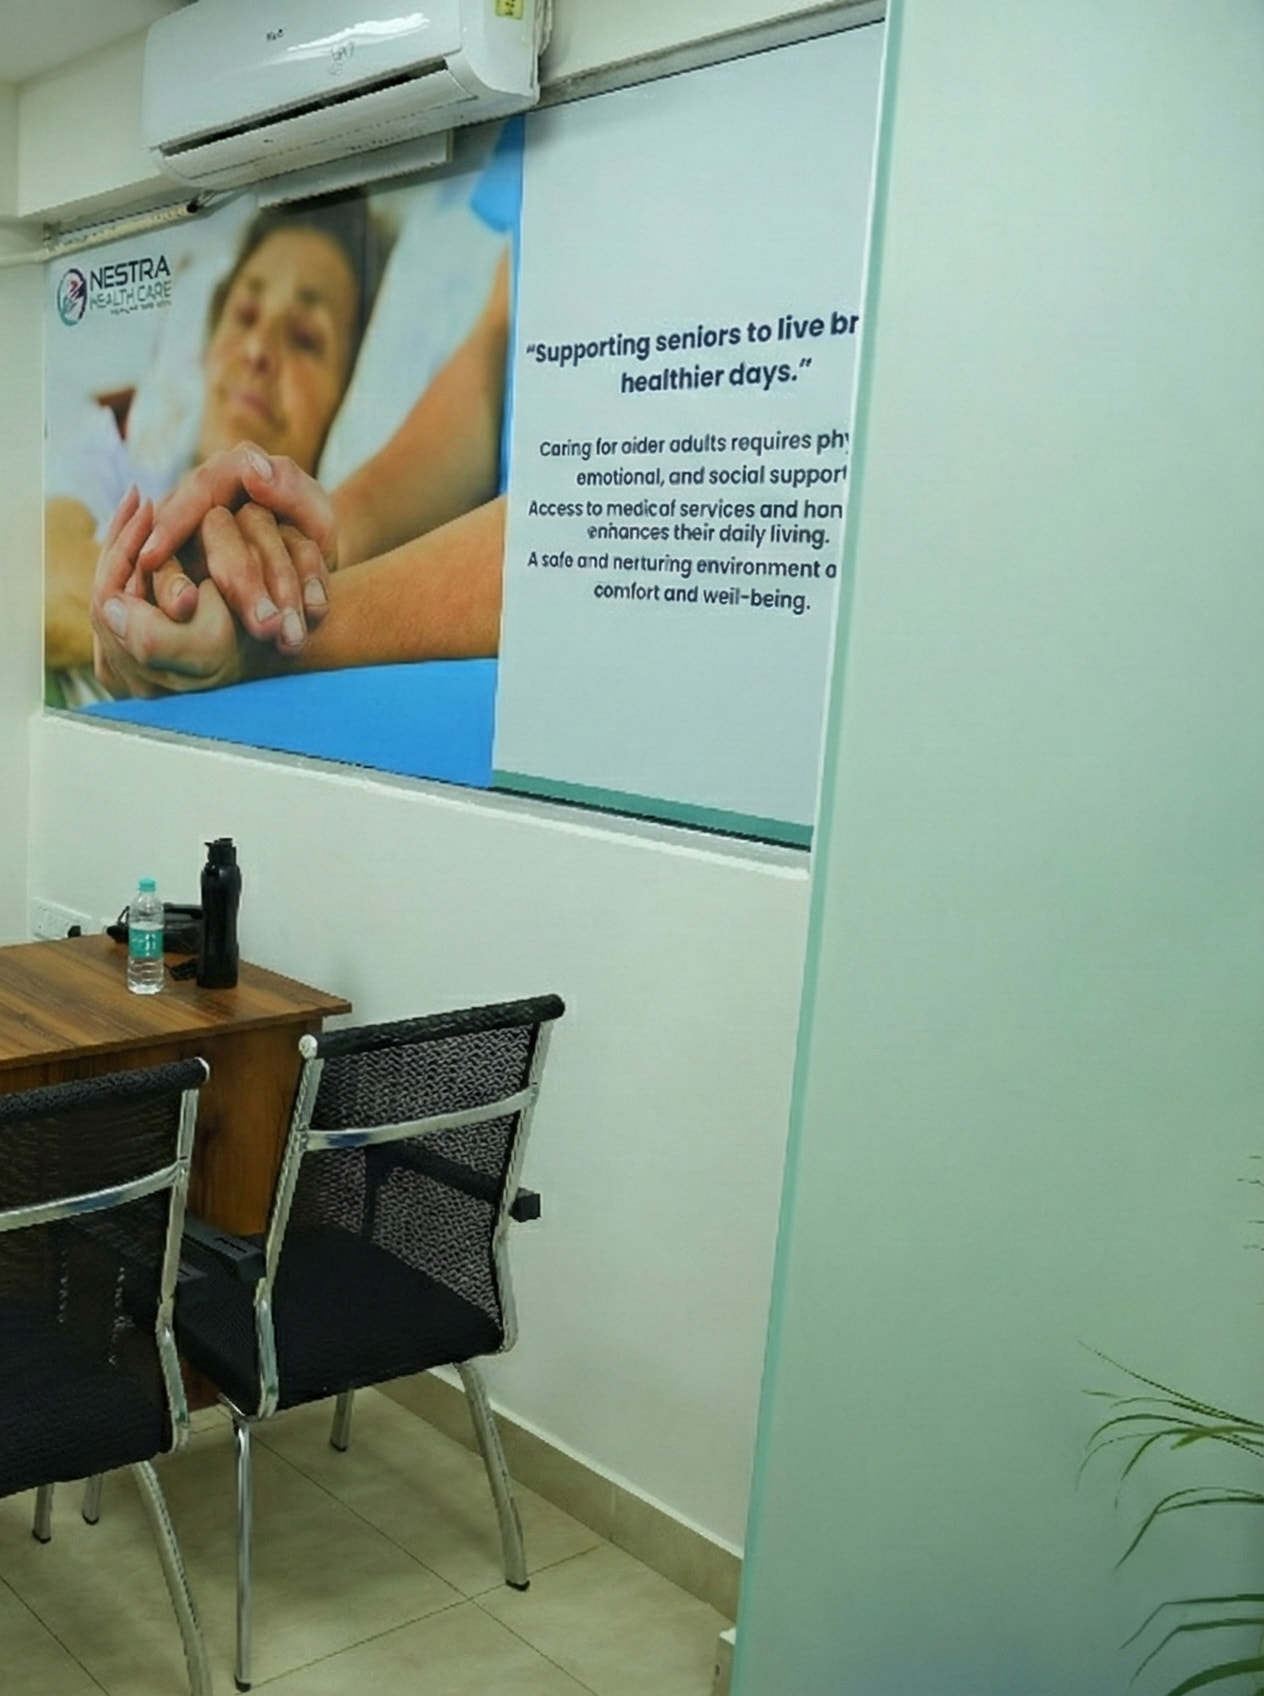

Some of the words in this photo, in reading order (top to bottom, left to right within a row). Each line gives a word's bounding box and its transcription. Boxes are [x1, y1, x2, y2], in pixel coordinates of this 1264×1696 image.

[90, 254, 171, 291] NESTRA
[655, 324, 742, 353] seniors
[746, 321, 773, 343] to
[777, 314, 826, 341] live
[620, 364, 726, 394] healthier
[539, 438, 593, 462] Caring
[595, 436, 619, 456] for
[668, 433, 727, 454] adults
[731, 429, 813, 457] requires
[576, 466, 665, 488] emotional,
[668, 465, 706, 486] and
[708, 464, 766, 485] social
[528, 499, 584, 518] Access
[586, 500, 604, 517] to
[679, 497, 756, 519] services
[759, 499, 799, 519] and
[673, 522, 716, 542] their
[718, 522, 767, 549] daily
[770, 523, 830, 551] living.
[527, 551, 539, 568] A
[541, 550, 574, 569] safe
[576, 552, 609, 570] and
[696, 555, 821, 579] environment
[593, 581, 661, 602] comfort
[663, 585, 699, 604] and
